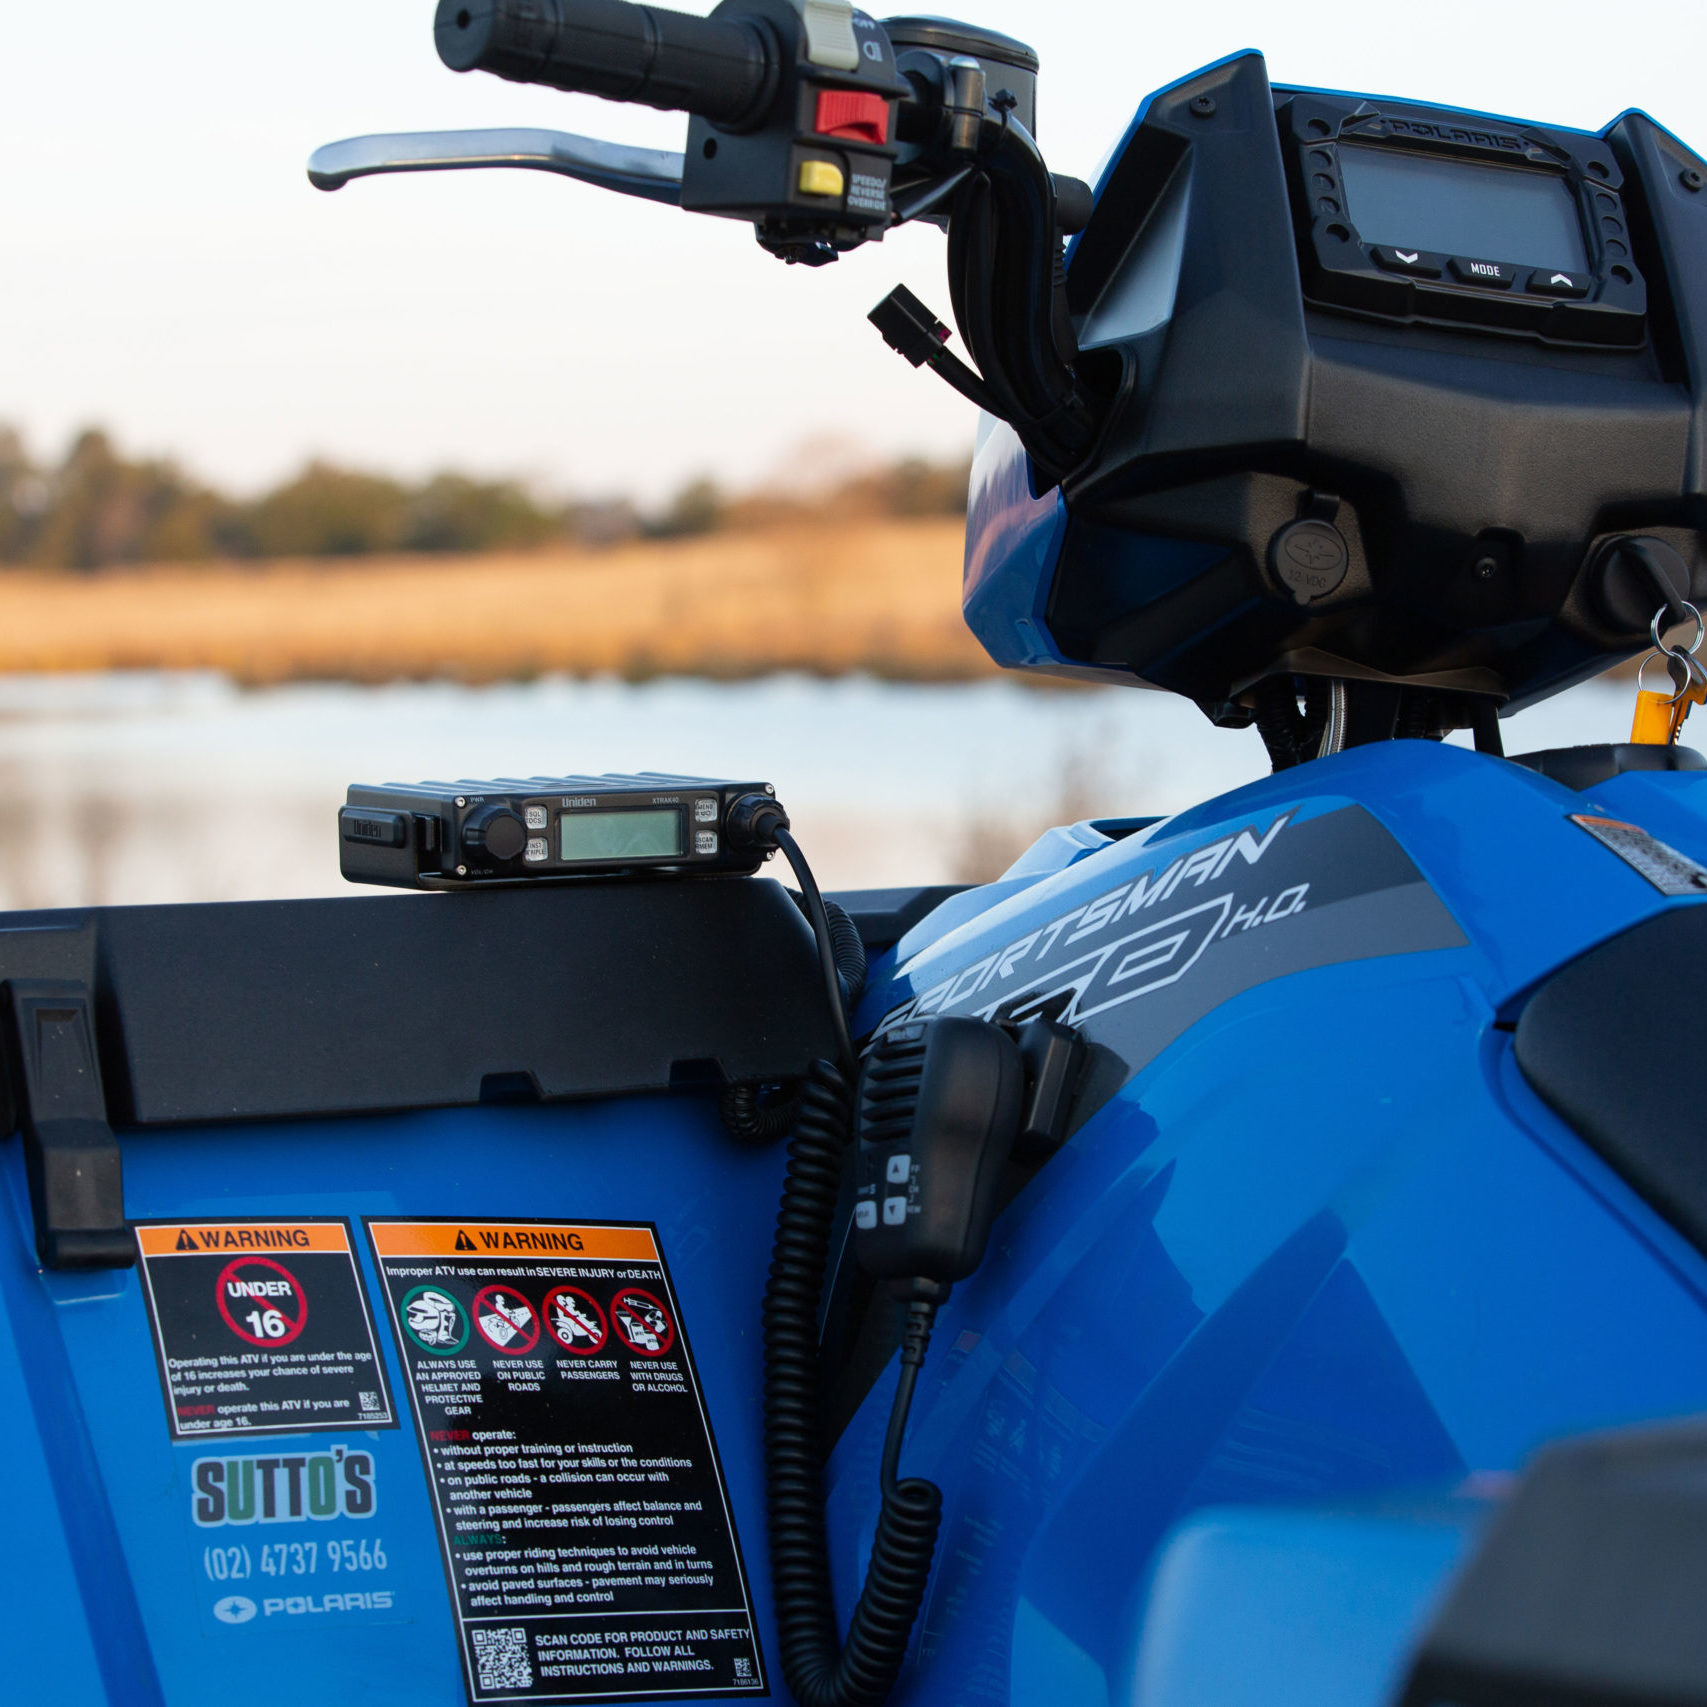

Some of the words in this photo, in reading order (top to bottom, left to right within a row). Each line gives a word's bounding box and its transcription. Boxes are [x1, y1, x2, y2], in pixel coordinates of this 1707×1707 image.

[1389, 119, 1522, 149] POLARIS
[1470, 262, 1501, 277] MODE
[562, 797, 596, 808] Uniden
[1221, 883, 1309, 937] H.O.
[868, 815, 1289, 1041] SPORTSMAN
[198, 1229, 309, 1247] WARNING
[478, 1231, 584, 1250] WARNING
[385, 1265, 432, 1277] Improper
[434, 1265, 454, 1275] ATV
[456, 1267, 476, 1275] use
[496, 1267, 525, 1276] result
[525, 1267, 536, 1276] in
[535, 1267, 578, 1277] SEVERE
[577, 1268, 614, 1277] INJURY
[616, 1270, 626, 1278] or
[626, 1269, 661, 1279] DEATH
[227, 1280, 293, 1298] UNDER
[245, 1310, 290, 1339] 16
[167, 1356, 219, 1370] Operating
[218, 1355, 238, 1365] this
[239, 1354, 259, 1364] ATV
[261, 1354, 268, 1362] if
[269, 1354, 288, 1364] you
[289, 1353, 305, 1361] are
[307, 1352, 334, 1362] under
[335, 1352, 352, 1360] the
[354, 1352, 371, 1361] age
[417, 1360, 456, 1369] ALWAYS
[456, 1360, 476, 1368] USE
[492, 1359, 523, 1368] NEVER
[524, 1359, 543, 1368] USE
[555, 1359, 586, 1368] NEVER
[587, 1359, 617, 1368] CARRY
[629, 1360, 659, 1369] NEVER
[659, 1361, 677, 1369] USE
[168, 1371, 181, 1381] of
[183, 1370, 196, 1380] 16
[197, 1369, 246, 1379] increases
[247, 1368, 270, 1378] your
[271, 1366, 308, 1376] chance
[309, 1365, 320, 1374] of
[321, 1365, 353, 1373] severe
[415, 1372, 429, 1380] AN
[431, 1371, 481, 1380] APPROVED
[496, 1371, 511, 1379] ON
[511, 1371, 545, 1379] PUBLIC
[560, 1370, 620, 1379] PASSENGERS
[629, 1371, 652, 1380] WITH
[653, 1372, 683, 1381] DRUGS
[170, 1383, 201, 1397] injury
[203, 1384, 214, 1393] or
[216, 1381, 248, 1392] death.
[420, 1383, 457, 1392] HELMET
[461, 1382, 480, 1391] AND
[507, 1382, 540, 1391] ROADS
[632, 1382, 645, 1391] OR
[647, 1383, 687, 1392] ALCOHOL
[424, 1394, 482, 1403] PROTECTIVE
[177, 1405, 215, 1416] NEVER
[216, 1402, 258, 1415] operate
[259, 1401, 280, 1411] this
[280, 1400, 301, 1410] ATV
[302, 1399, 310, 1408] if
[311, 1400, 332, 1410] you
[332, 1399, 349, 1408] are
[444, 1406, 471, 1415] GEAR
[178, 1419, 211, 1431] under
[213, 1418, 234, 1430] age
[235, 1416, 252, 1427] 16.
[430, 1430, 470, 1441] NEVER
[471, 1429, 516, 1442] operate:
[439, 1445, 481, 1456] without
[483, 1445, 518, 1456] proper
[520, 1443, 562, 1455] training
[564, 1444, 575, 1453] or
[577, 1442, 633, 1453] instruction
[443, 1460, 455, 1470] at
[456, 1459, 496, 1472] speeds
[497, 1459, 516, 1469] too
[517, 1459, 538, 1468] fast
[539, 1458, 555, 1468] for
[556, 1459, 579, 1470] your
[580, 1458, 606, 1467] skills
[607, 1459, 618, 1467] or
[620, 1457, 637, 1467] the
[639, 1457, 692, 1467] conditions
[196, 1447, 374, 1522] SUTTO'S
[446, 1476, 462, 1486] on
[463, 1474, 498, 1487] public
[499, 1473, 531, 1483] roads
[539, 1474, 546, 1482] a
[548, 1472, 593, 1482] collision
[594, 1473, 614, 1482] can
[616, 1473, 645, 1481] occur
[647, 1471, 669, 1481] with
[449, 1489, 491, 1500] another
[493, 1488, 532, 1498] vehicle
[452, 1504, 477, 1516] with
[478, 1505, 486, 1514] a
[487, 1504, 542, 1516] passenger
[551, 1503, 611, 1514] passengers
[612, 1501, 641, 1511] affect
[642, 1500, 681, 1510] balance
[683, 1500, 702, 1510] and
[203, 1545, 251, 1580] (02)
[260, 1541, 317, 1576] 4737
[326, 1538, 387, 1571] 9566
[462, 1551, 483, 1561] use
[484, 1550, 521, 1562] proper
[523, 1547, 556, 1560] riding
[556, 1546, 615, 1558] techniques
[617, 1545, 628, 1555] to
[630, 1545, 658, 1555] avoid
[660, 1544, 696, 1554] vehicle
[464, 1564, 518, 1576] overturns
[519, 1564, 534, 1573] on
[535, 1562, 560, 1573] hills
[561, 1561, 582, 1572] and
[583, 1560, 615, 1573] rough
[616, 1560, 651, 1570] terrain
[653, 1559, 672, 1569] and
[674, 1559, 684, 1569] in
[685, 1559, 713, 1569] turns
[263, 1591, 392, 1616] POLARIS
[470, 1595, 502, 1606] affect
[503, 1593, 552, 1605] handling
[553, 1592, 574, 1603] and
[576, 1590, 614, 1602] control
[534, 1634, 567, 1646] SCAN
[569, 1633, 602, 1644] CODE
[604, 1632, 628, 1643] FOR
[629, 1630, 681, 1641] PRODUCT
[685, 1629, 707, 1639] AND
[709, 1628, 749, 1639] SAFETY
[537, 1647, 620, 1661] INFORMATION.
[624, 1646, 670, 1657] FOLLOW
[674, 1645, 694, 1655] ALL
[540, 1662, 624, 1676] INSTRUCTIONS
[626, 1661, 650, 1672] AND
[651, 1659, 713, 1671] WARNINGS.
